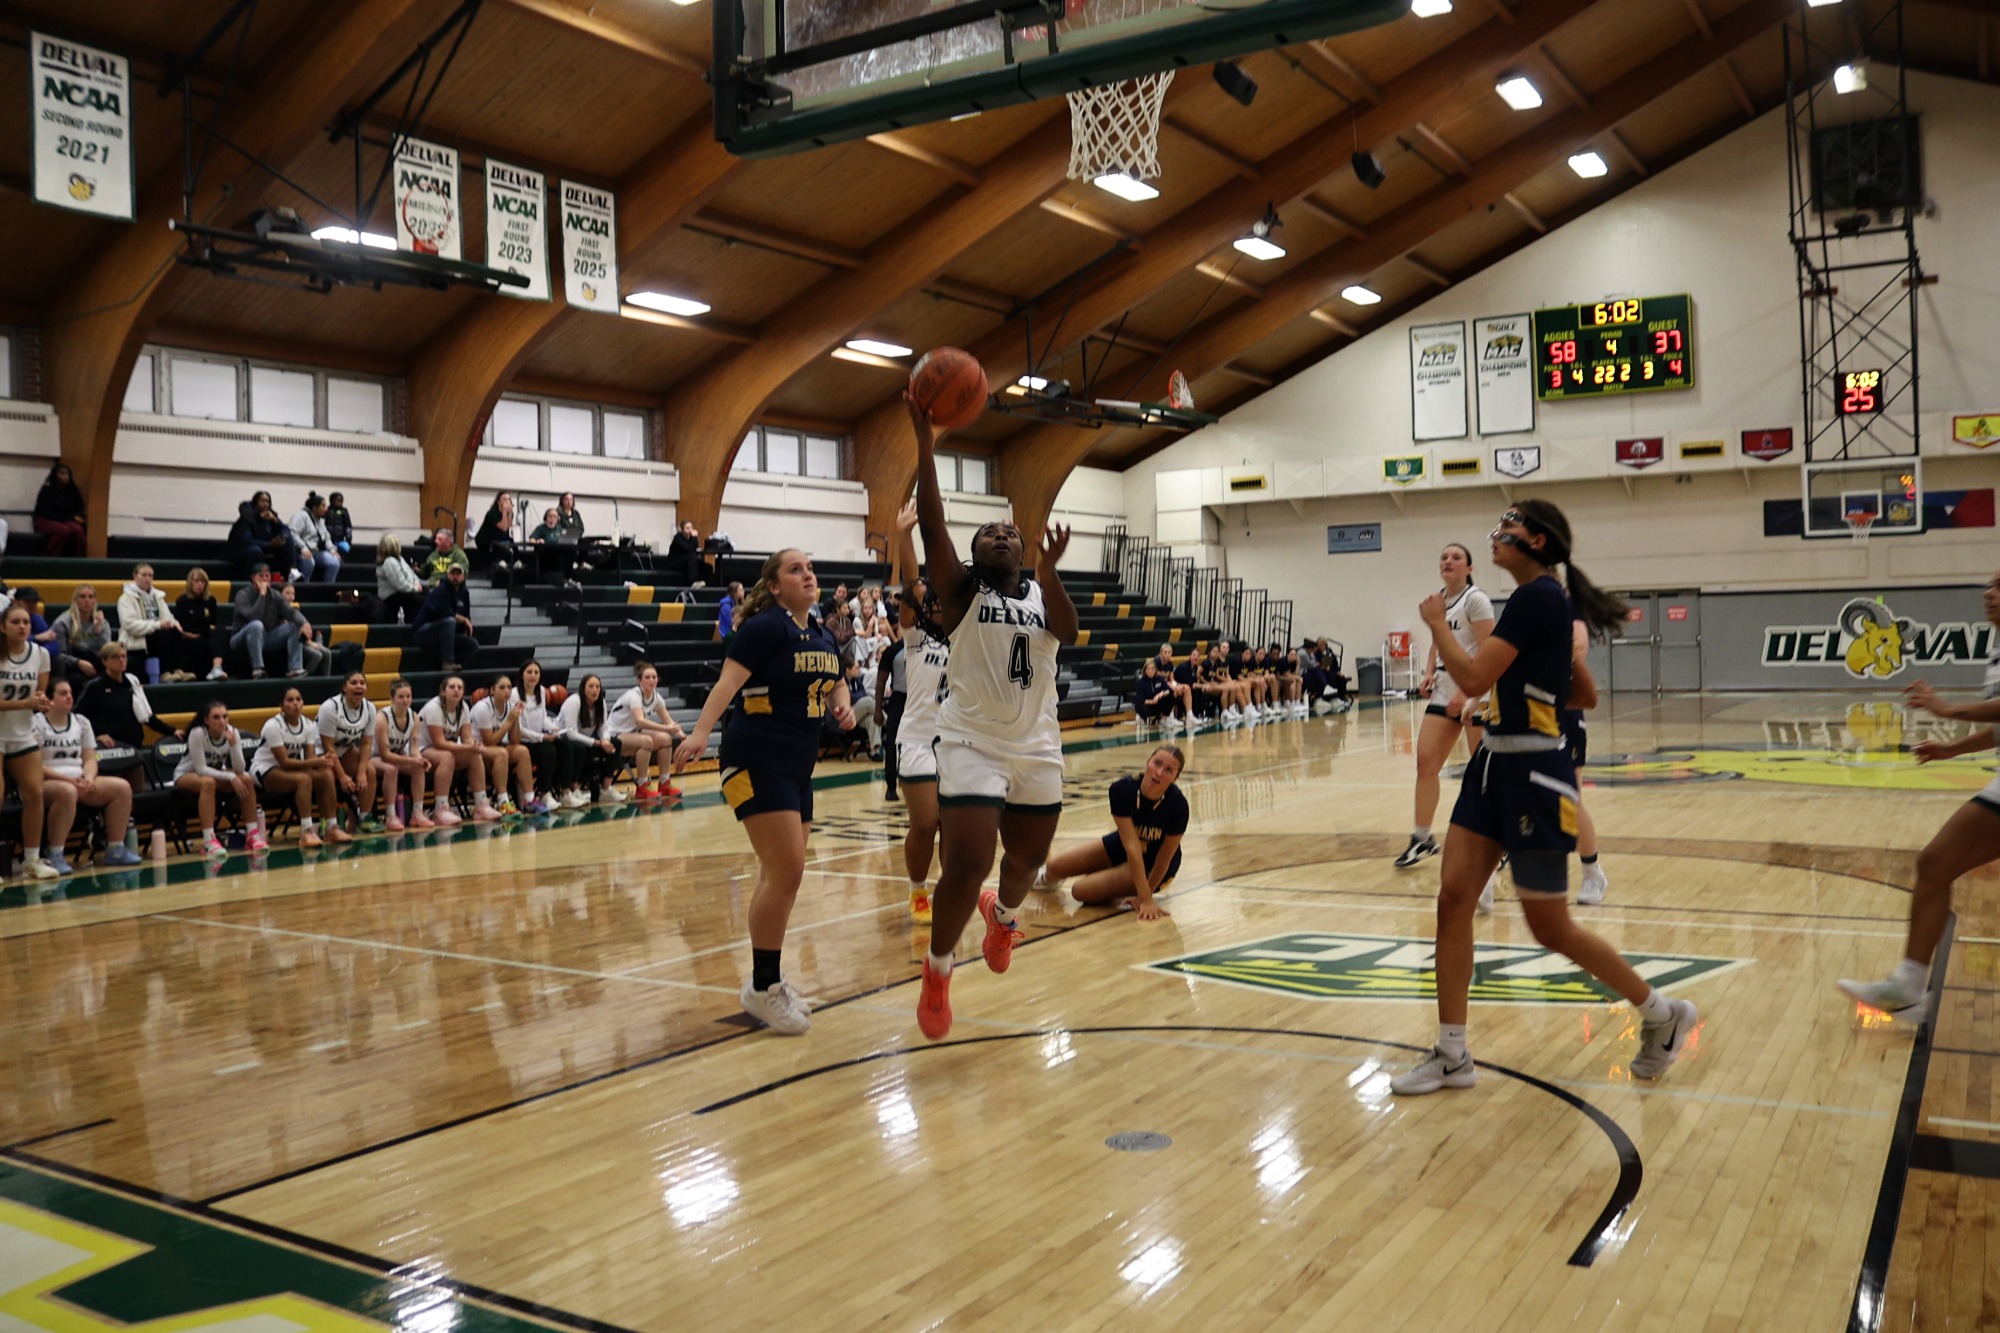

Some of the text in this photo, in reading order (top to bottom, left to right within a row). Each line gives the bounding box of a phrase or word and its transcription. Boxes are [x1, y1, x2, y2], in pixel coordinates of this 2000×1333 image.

[40, 39, 123, 79] DELVAL
[43, 75, 121, 116] NCAA
[42, 109, 124, 139] SECOND ROUND
[56, 135, 111, 164] 2021
[399, 139, 454, 169] DELVAL
[400, 169, 451, 199] NCAA
[490, 166, 540, 191] DELVAL
[492, 192, 538, 221] NCAA
[565, 187, 611, 210] DELVAL
[507, 219, 530, 232] FIRST
[565, 212, 609, 238] NCAA
[503, 230, 531, 245] ROUND
[580, 237, 600, 249] FIRST
[498, 241, 533, 264] 2023
[576, 248, 602, 261] ROUND
[573, 258, 608, 280] 2025
[1594, 299, 1639, 325] 6:02
[1495, 322, 1517, 332] GOLF
[1600, 330, 1623, 339] PERIOD
[1648, 319, 1678, 332] GUEST
[1544, 330, 1575, 342] AGGIES
[1655, 329, 1682, 354] 37
[1486, 345, 1520, 360] MAC
[1550, 340, 1576, 364] 58
[1606, 339, 1617, 355] 4
[1420, 352, 1456, 367] MAC
[1480, 361, 1527, 373] CHAMPIONS
[1669, 359, 1682, 376] 4
[1417, 369, 1462, 381] CHAMPIONS
[1551, 369, 1563, 389] 3
[1572, 368, 1584, 385] 4
[1594, 365, 1615, 384] 22
[1620, 363, 1631, 382] 2
[1643, 361, 1654, 380] 3
[1845, 371, 1880, 389] 6:02
[1843, 386, 1875, 412] 25
[978, 604, 1047, 630] DELVA
[1765, 626, 1991, 662] DEL VAL
[1008, 633, 1034, 690] 4
[3, 684, 32, 701] 22
